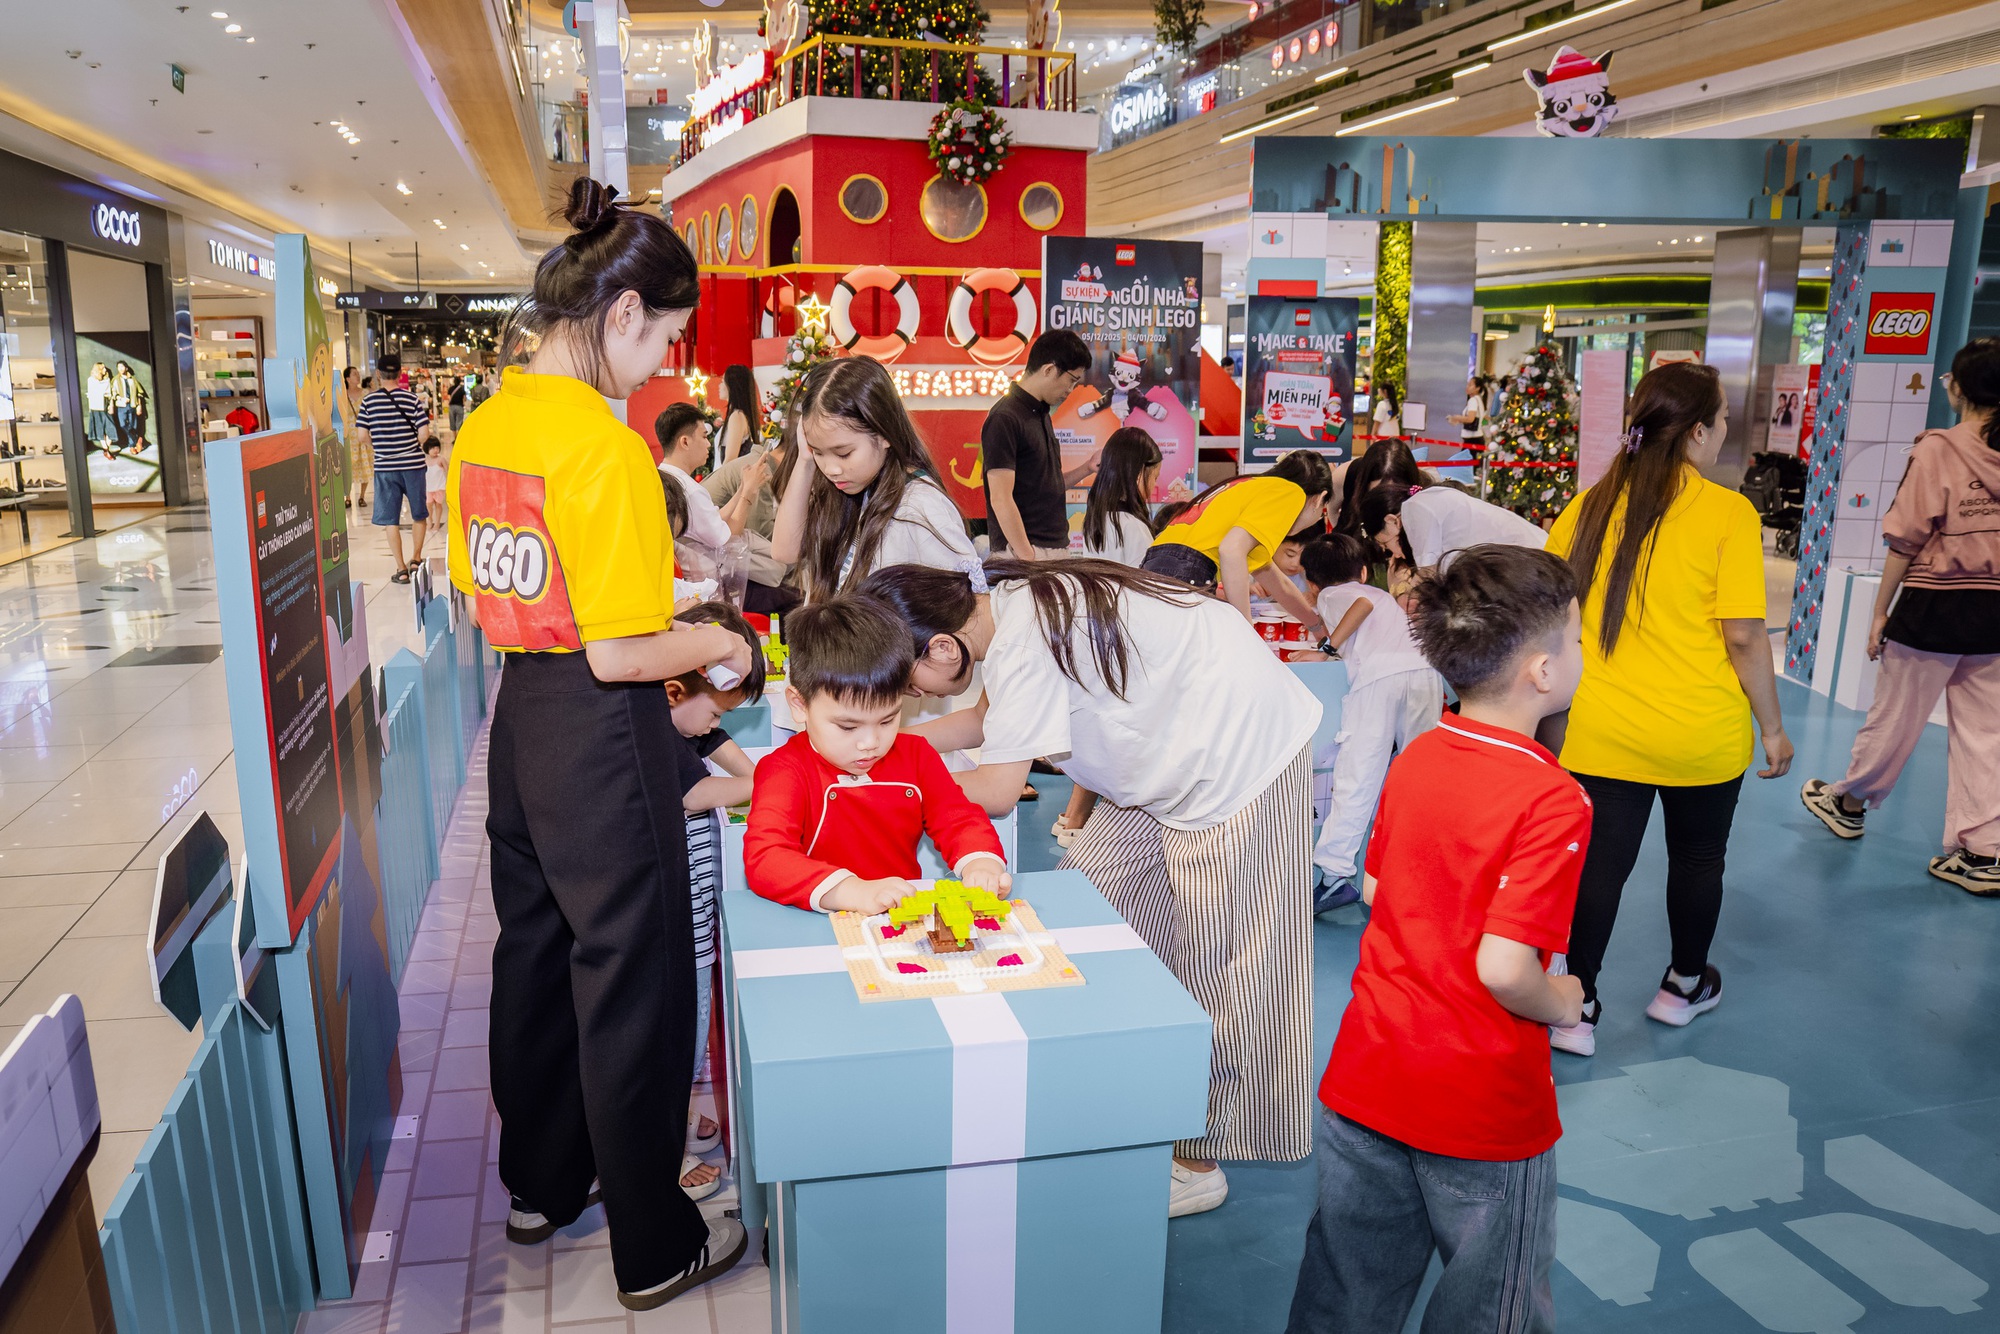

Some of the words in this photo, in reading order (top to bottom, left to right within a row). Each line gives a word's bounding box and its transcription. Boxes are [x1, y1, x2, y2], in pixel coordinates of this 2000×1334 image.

[1111, 88, 1153, 134] OSIM
[97, 203, 141, 247] ecco
[208, 239, 248, 273] TOMMY
[1117, 250, 1135, 259] LEGO
[1066, 286, 1078, 299] SỰ
[1080, 286, 1100, 299] KIỆN
[1154, 286, 1185, 307] NHÀ
[1050, 302, 1105, 330] GIÁNG
[1108, 306, 1153, 330] SINH
[1155, 308, 1196, 328] LEGO
[1872, 312, 1927, 335] LEGO
[1081, 332, 1121, 342] 05/12/2025
[1127, 333, 1167, 342] 04/01/2026
[1257, 332, 1296, 352] MAKE
[1298, 338, 1307, 348] &
[1309, 334, 1346, 353] TAKE
[1267, 388, 1298, 405] MIỄN
[1301, 389, 1322, 408] PHÍ
[469, 523, 544, 596] LEGO
